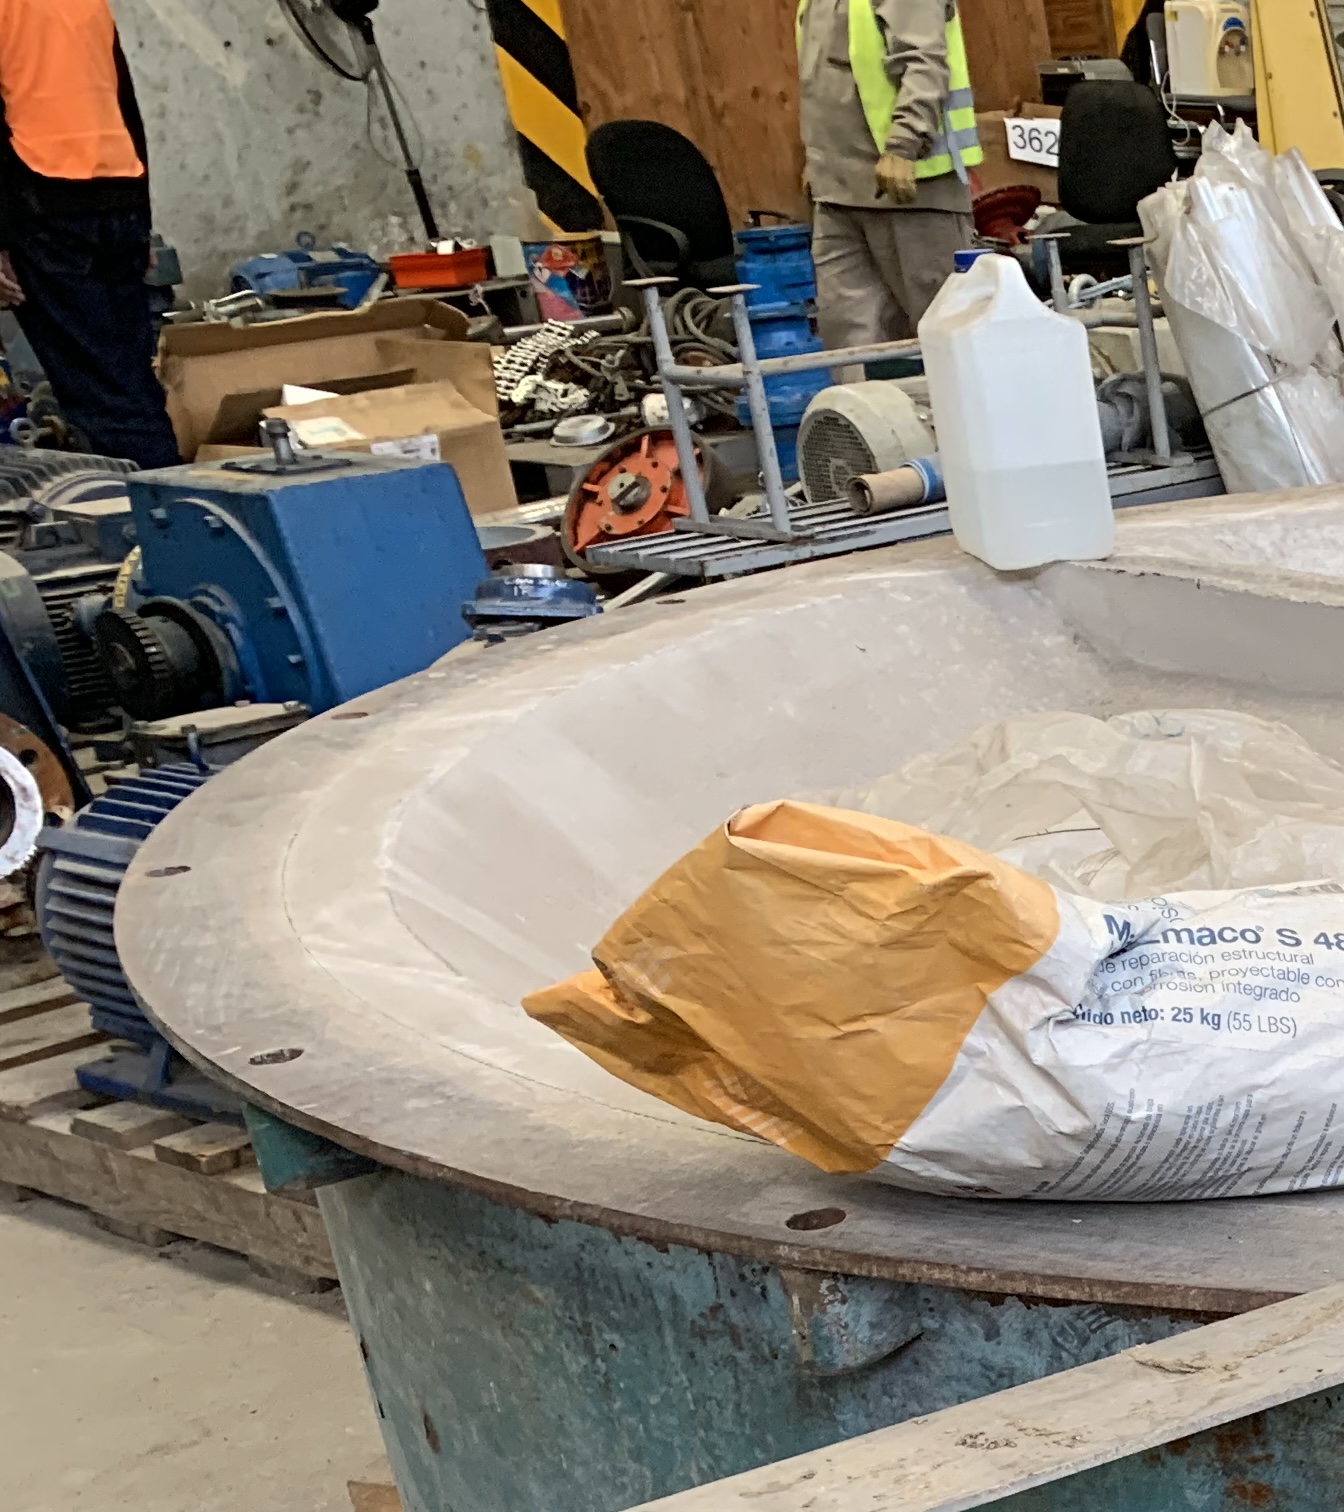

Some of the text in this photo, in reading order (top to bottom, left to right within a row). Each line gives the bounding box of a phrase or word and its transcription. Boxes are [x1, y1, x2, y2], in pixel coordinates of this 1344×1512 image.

[1011, 124, 1060, 156] 362
[1275, 927, 1302, 948] S
[1121, 950, 1215, 971] reparación
[1220, 947, 1315, 966] estructural
[1111, 975, 1144, 993] con
[1208, 964, 1310, 985] proyectable
[1222, 979, 1301, 1003] integrado
[1120, 1005, 1165, 1023] neto:
[1171, 1007, 1194, 1024] 25
[1200, 1007, 1221, 1031] kg
[1226, 1010, 1252, 1034] (55
[1257, 1014, 1297, 1039] LBS)
